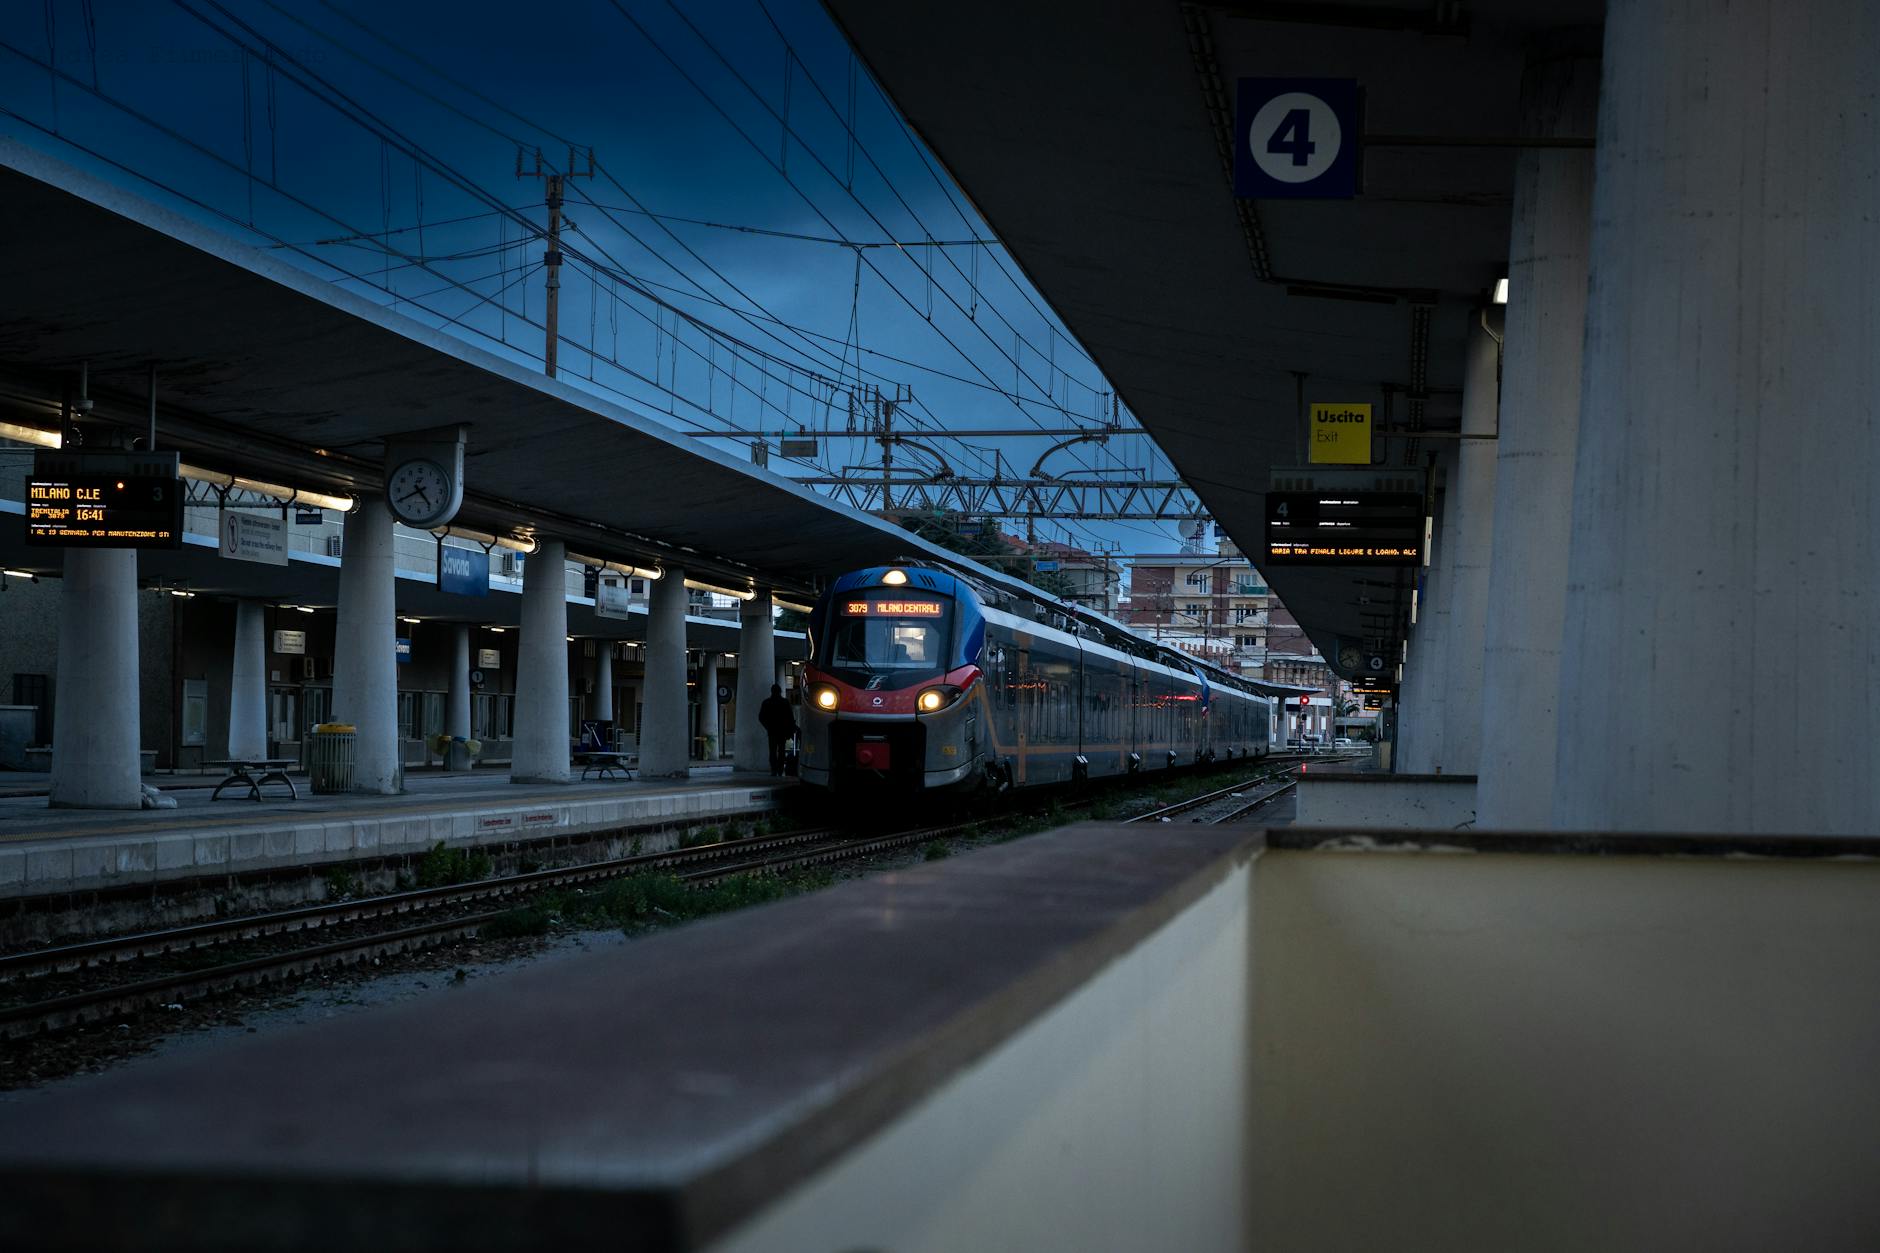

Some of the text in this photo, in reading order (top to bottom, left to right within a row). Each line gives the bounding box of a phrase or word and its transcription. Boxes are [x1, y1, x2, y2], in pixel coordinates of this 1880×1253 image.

[1267, 109, 1315, 166] 4
[1317, 410, 1364, 423] Uscita
[1317, 430, 1338, 442] Exit
[31, 487, 101, 500] MILANO C.LE
[152, 487, 164, 502] 3
[76, 509, 104, 521] 16:41
[1276, 501, 1289, 518] 4
[443, 551, 470, 576] Savona
[848, 603, 940, 613] 3079 MILANO CENTRALE
